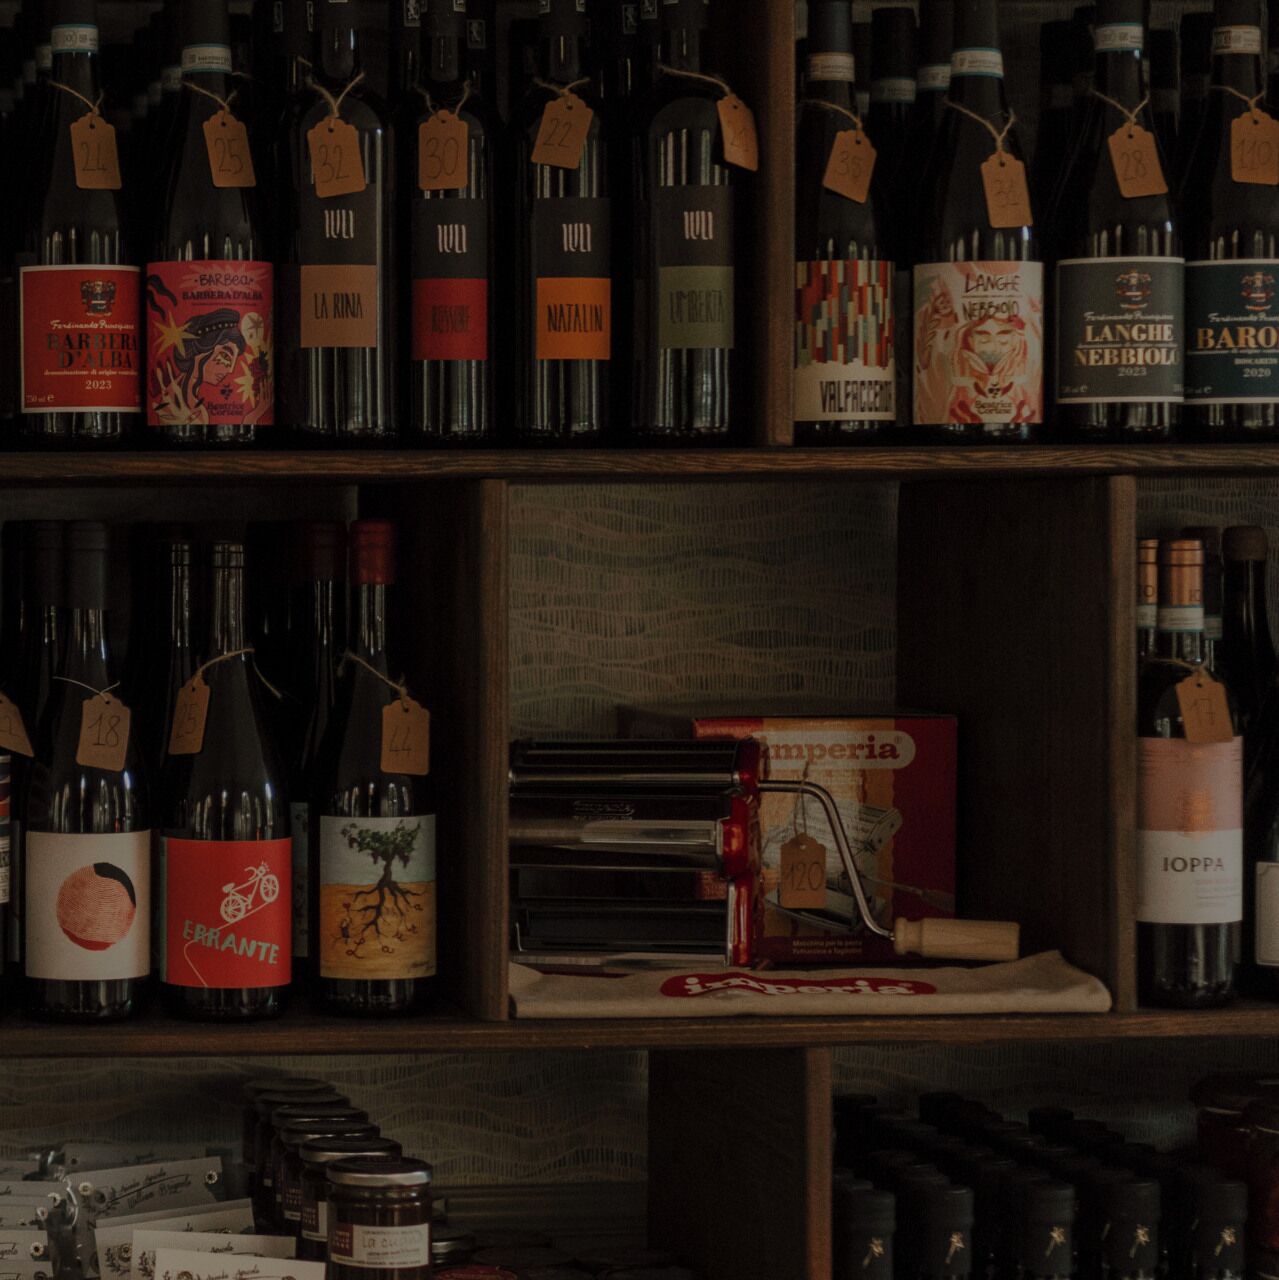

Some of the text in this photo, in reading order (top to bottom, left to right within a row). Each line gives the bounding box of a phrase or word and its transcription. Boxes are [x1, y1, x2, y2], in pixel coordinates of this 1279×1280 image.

[424, 137, 459, 179] 30
[313, 292, 363, 320] LA RINA
[546, 303, 603, 332] NATALIN
[47, 332, 138, 352] BARBERA
[1084, 323, 1174, 342] LANGHE
[58, 351, 134, 370] D'ALBA
[1118, 366, 1147, 377] 2023
[85, 379, 113, 391] 2023
[87, 712, 121, 748] 18
[790, 860, 822, 892] 120
[1162, 856, 1225, 873] IOPPA
[182, 919, 280, 965] ERRANTE
